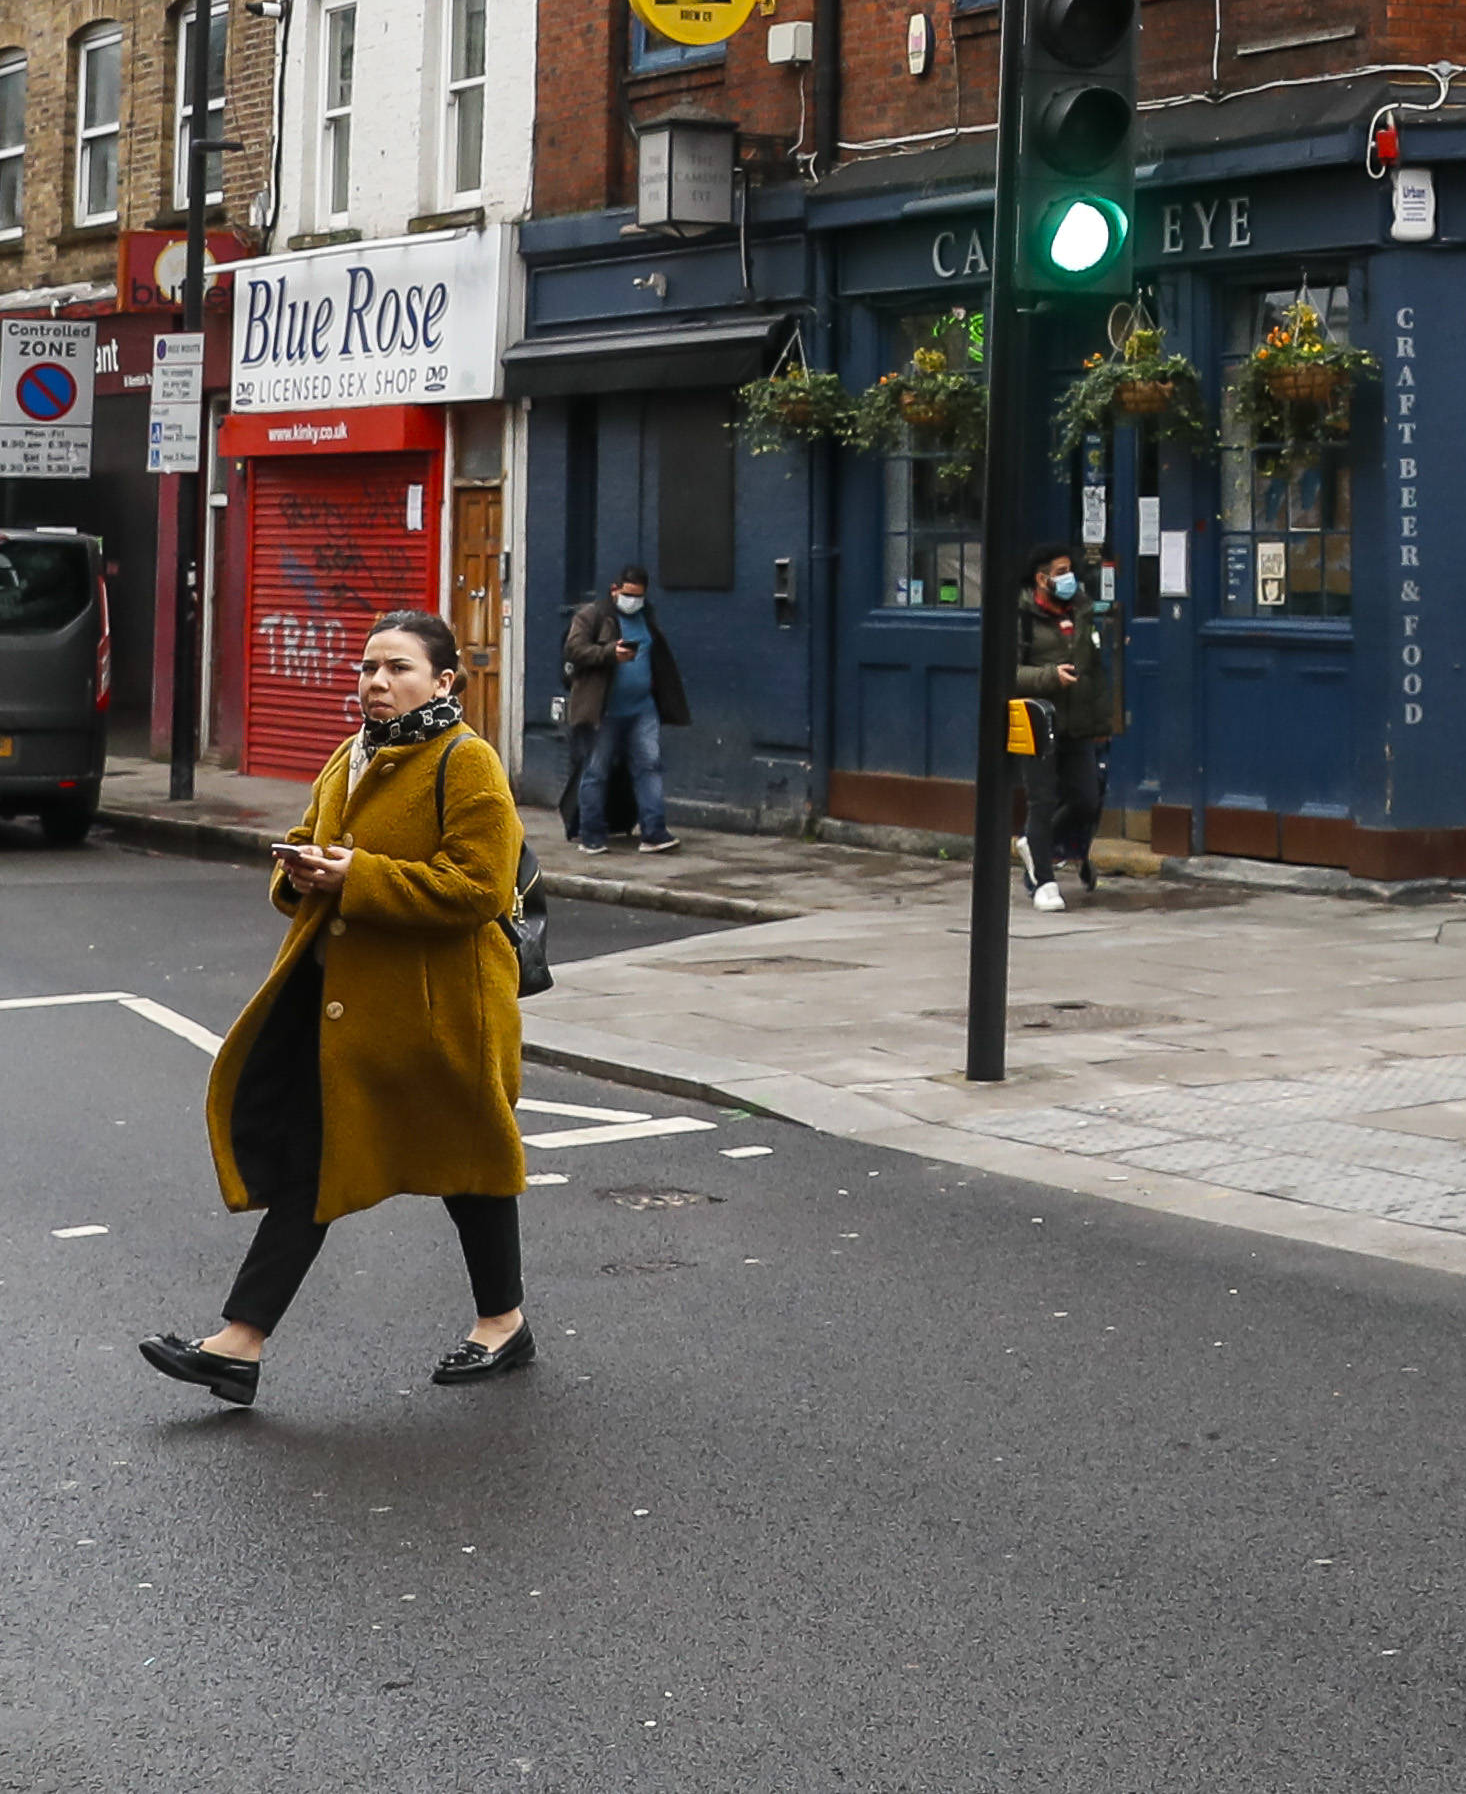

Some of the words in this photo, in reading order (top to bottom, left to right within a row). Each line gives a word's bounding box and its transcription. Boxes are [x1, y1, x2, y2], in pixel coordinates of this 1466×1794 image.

[1162, 197, 1251, 254] EYE
[8, 323, 91, 338] Controlled
[240, 275, 334, 367] Blue
[338, 266, 448, 358] Rose
[19, 341, 77, 357] ZONE
[258, 375, 332, 404] LICENSED
[338, 372, 367, 398] SEX
[375, 368, 417, 395] SHOP
[425, 365, 448, 382] DVD
[1396, 307, 1417, 444] CRAFT
[268, 421, 348, 444] www.kinky.co.uk
[1399, 457, 1420, 566] BEER
[1401, 579, 1421, 602] &
[1402, 614, 1423, 725] FOOD
